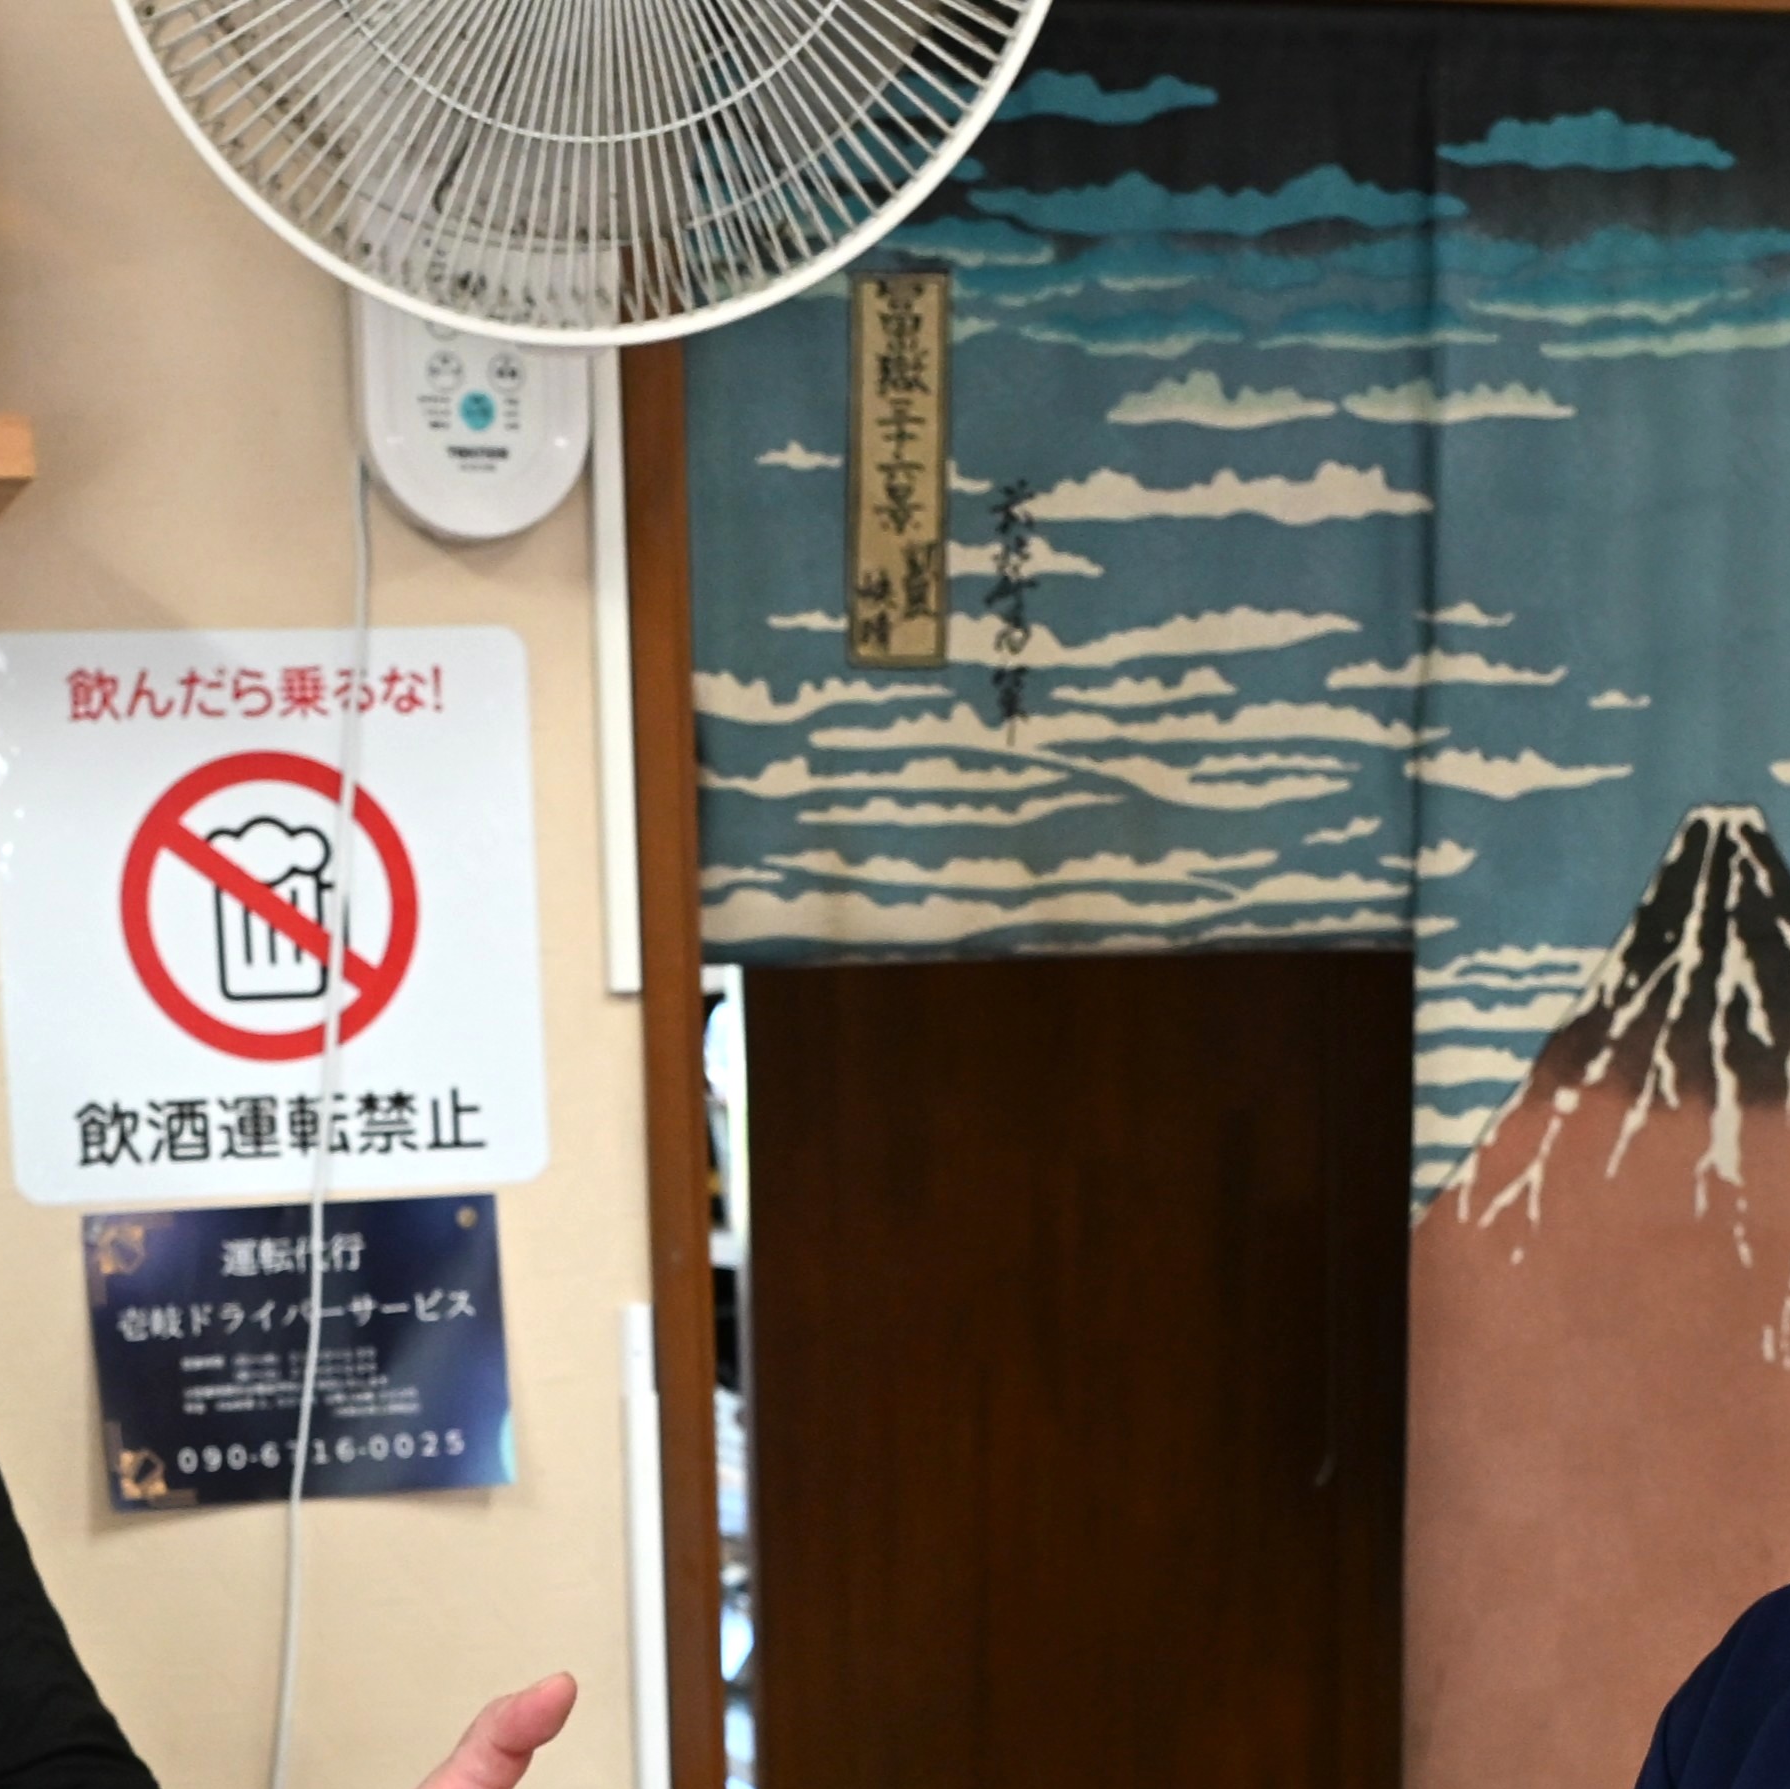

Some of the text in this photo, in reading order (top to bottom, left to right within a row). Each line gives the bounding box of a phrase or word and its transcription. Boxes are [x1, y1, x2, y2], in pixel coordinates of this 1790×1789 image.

[64, 663, 446, 723] 飲んだら乗るな!
[74, 1086, 489, 1168] 飲酒運転禁止
